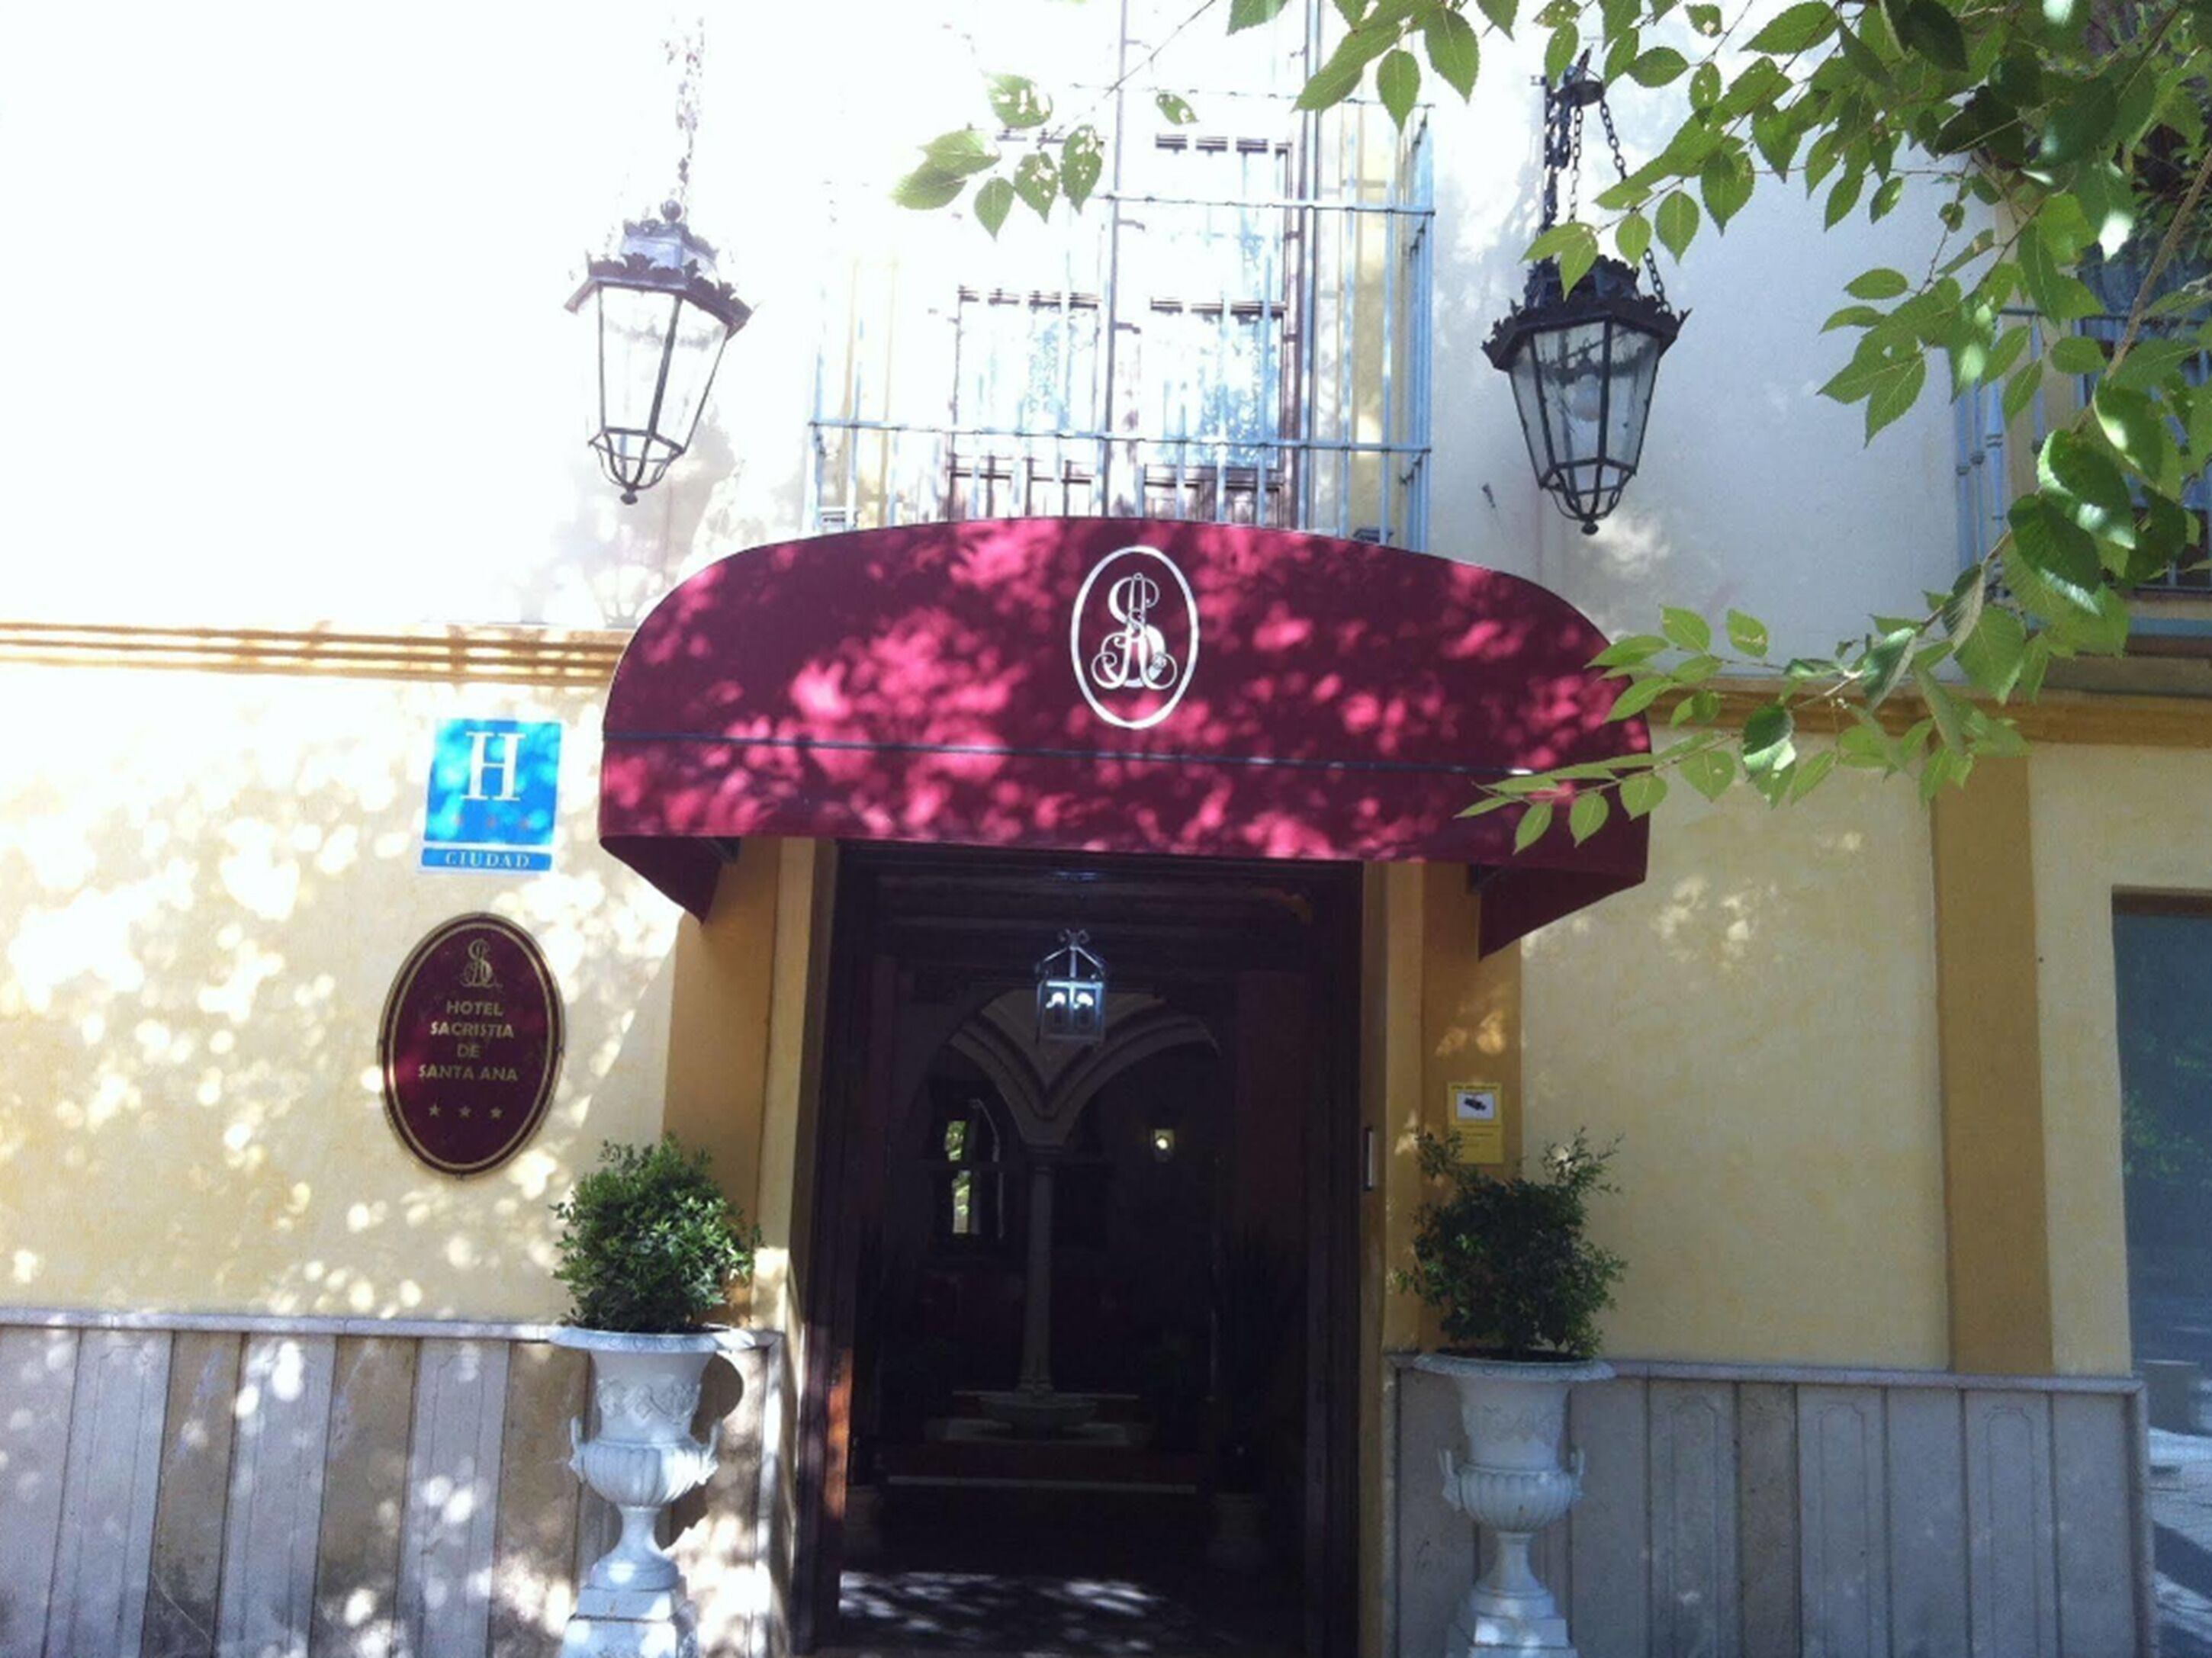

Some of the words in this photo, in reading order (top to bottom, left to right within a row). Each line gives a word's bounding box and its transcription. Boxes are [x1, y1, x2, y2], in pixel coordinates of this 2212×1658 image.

[460, 731, 526, 802] H
[445, 851, 530, 869] CIUDAD
[446, 1000, 504, 1017] HOTEL
[430, 1021, 515, 1038] SACRISTIA
[457, 1043, 481, 1059] DE
[418, 1064, 474, 1080] SANTA
[480, 1066, 518, 1081] ANA
